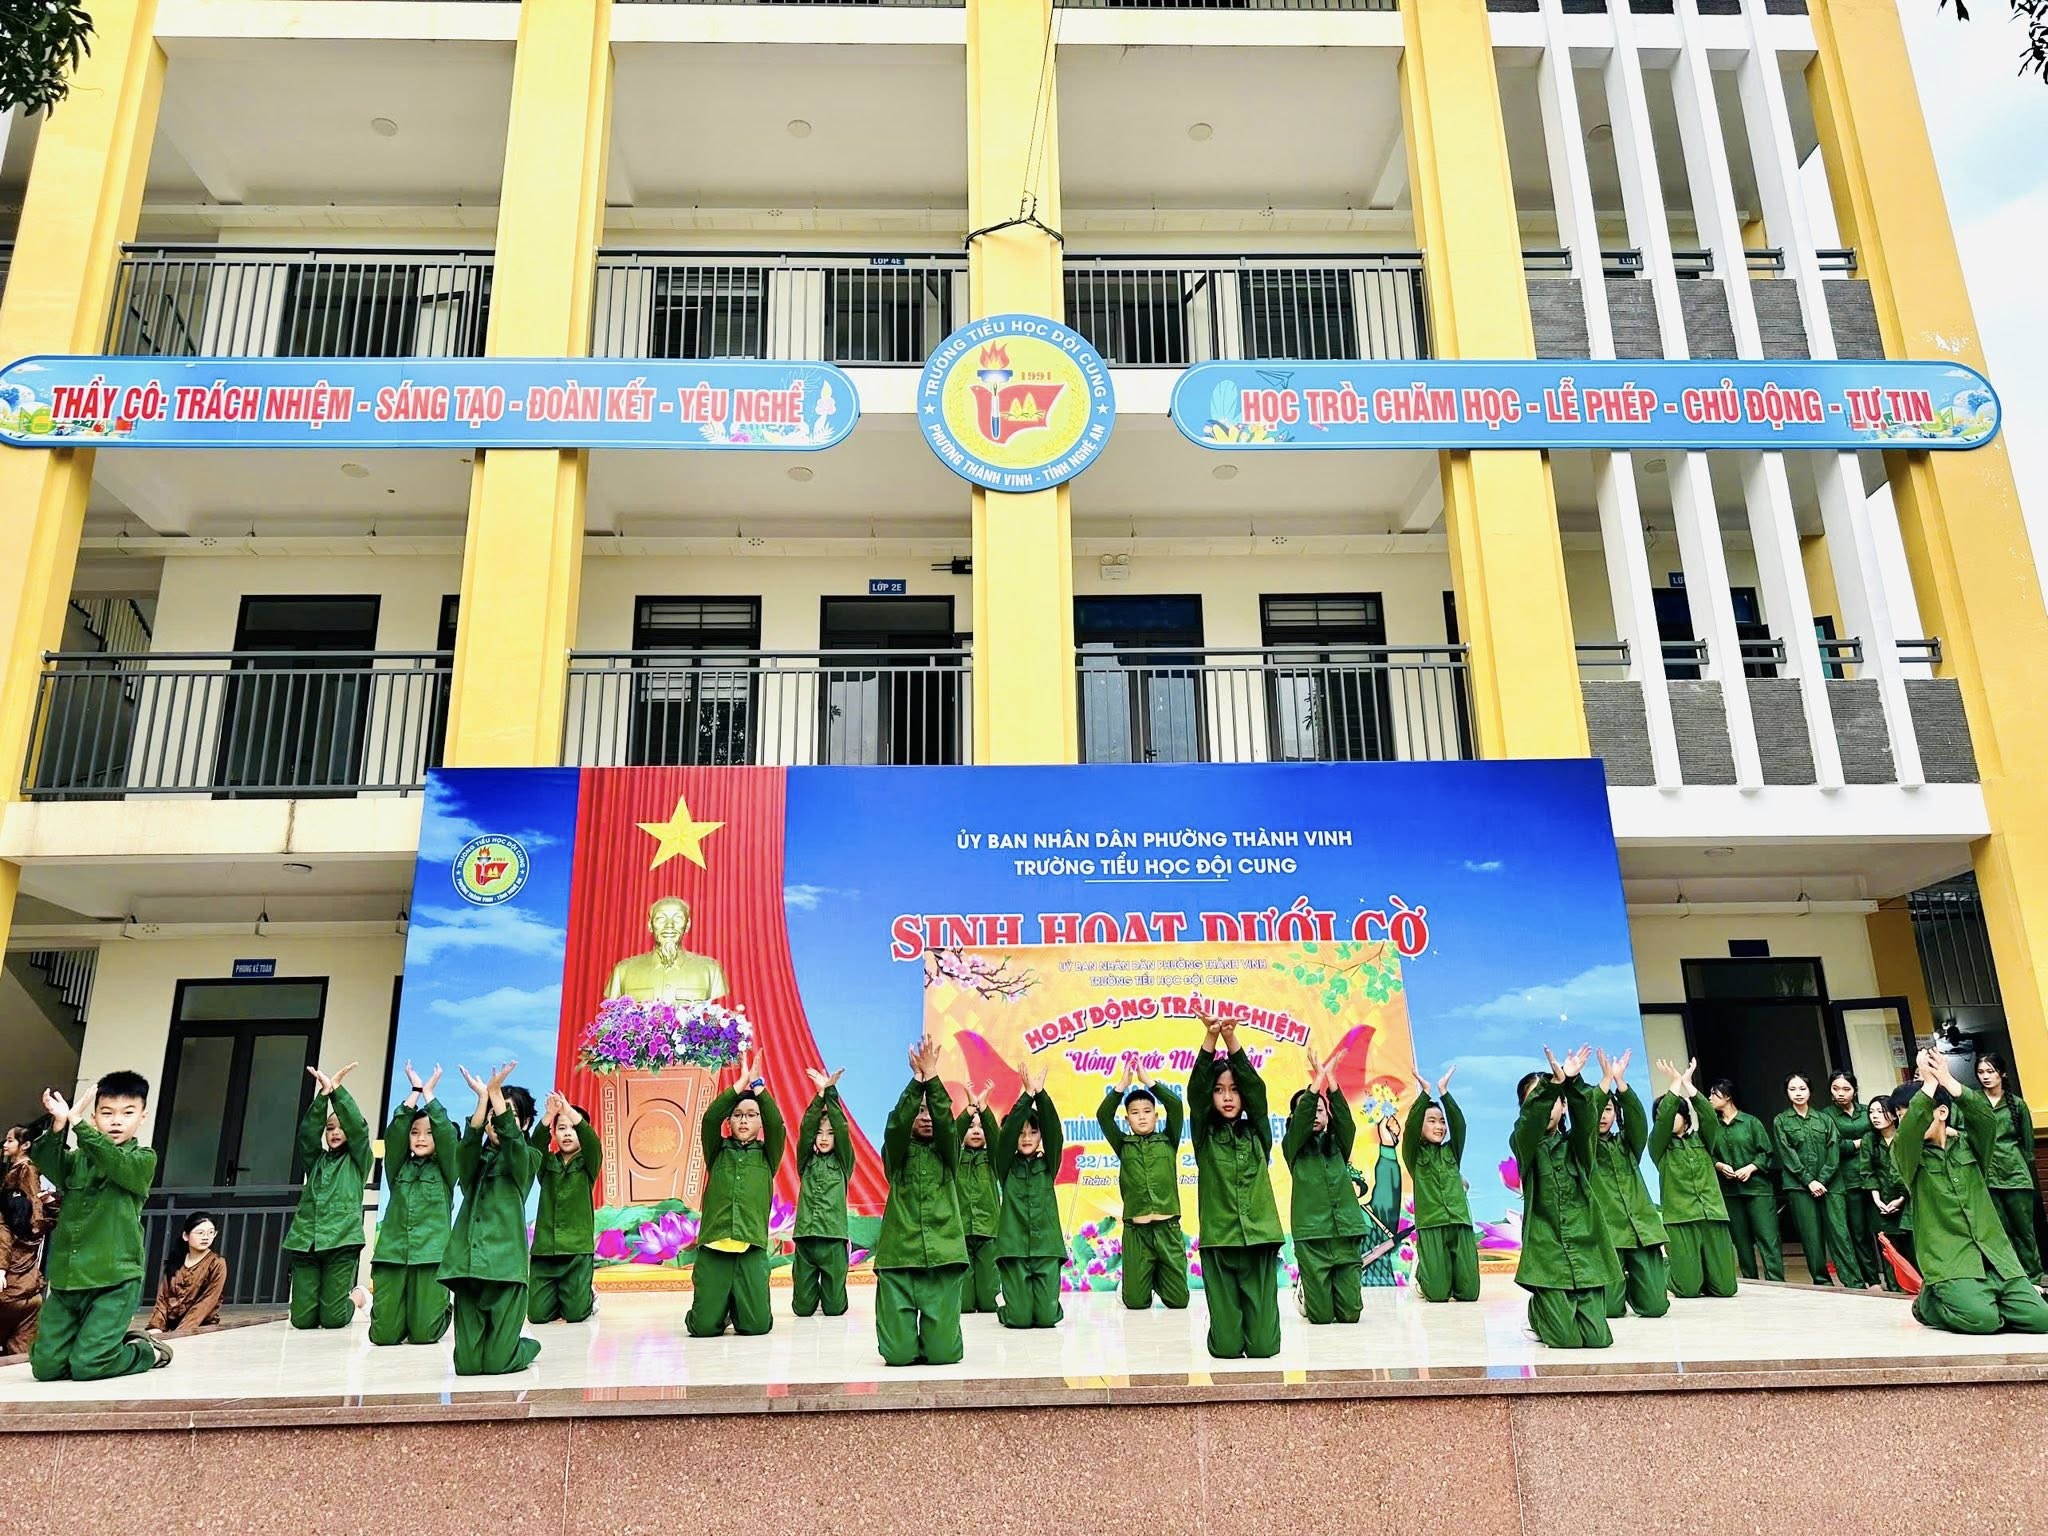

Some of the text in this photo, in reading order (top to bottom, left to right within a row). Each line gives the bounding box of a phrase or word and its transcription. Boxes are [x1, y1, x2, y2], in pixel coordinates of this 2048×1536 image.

[924, 317, 1107, 398] TRƯỜNG TIỂU HỌC ĐỘI CUNG
[1021, 371, 1052, 381] 1991
[51, 376, 116, 420] THẦY
[123, 381, 167, 420] CÔ:
[174, 380, 260, 420] TRÁCH
[263, 381, 354, 428] NHIỆM
[376, 380, 449, 421] SÁNG
[455, 387, 503, 428] TẠO
[527, 380, 603, 421] ĐOÀN
[606, 378, 657, 421] KẾT
[678, 382, 731, 423] YÊU
[734, 380, 805, 424] NGHỀ
[1241, 389, 1299, 430] HỌC
[1304, 381, 1369, 424] TRÒ:
[1374, 382, 1457, 422] CHĂM
[1461, 389, 1520, 430] HỌC
[1545, 377, 1579, 422] LỄ
[1583, 382, 1656, 423] PHÉP
[1682, 378, 1739, 423] CHỦ
[1744, 383, 1824, 430] ĐỘNG
[1845, 387, 1885, 430] TỰ
[1885, 390, 1935, 424] TIN
[928, 423, 965, 466] PHƯỜNG
[962, 462, 1001, 484] THÀNH
[1004, 474, 1033, 486] VINH
[1042, 464, 1071, 482] TỈNH
[1071, 439, 1097, 470] NGHỆ
[1092, 424, 1106, 441] AN
[891, 583, 902, 592] 2E
[957, 827, 1353, 849] ỦY BAN NHÂN DÂN PHƯỜNG THÀNH VINH
[1014, 851, 1298, 878] TRƯỜNG TIỂU HỌC ĐỘI CUNG
[890, 913, 1024, 962] SINH
[1352, 894, 1430, 957] CỜ
[1075, 962, 1097, 971] BAN
[1100, 960, 1131, 971] NHÂN
[1132, 960, 1156, 970] DÂN
[1158, 958, 1203, 969] PHƯỜNG
[1205, 957, 1240, 969] THÀNH
[1241, 960, 1267, 969] VINH
[1090, 974, 1133, 986] TRƯỜNG
[1157, 976, 1182, 987] HỌC
[1183, 974, 1203, 987] ĐỘI
[1206, 975, 1238, 985] CUNG
[1024, 1009, 1087, 1053] HOẠT
[1217, 1000, 1310, 1046] NGHIỆM
